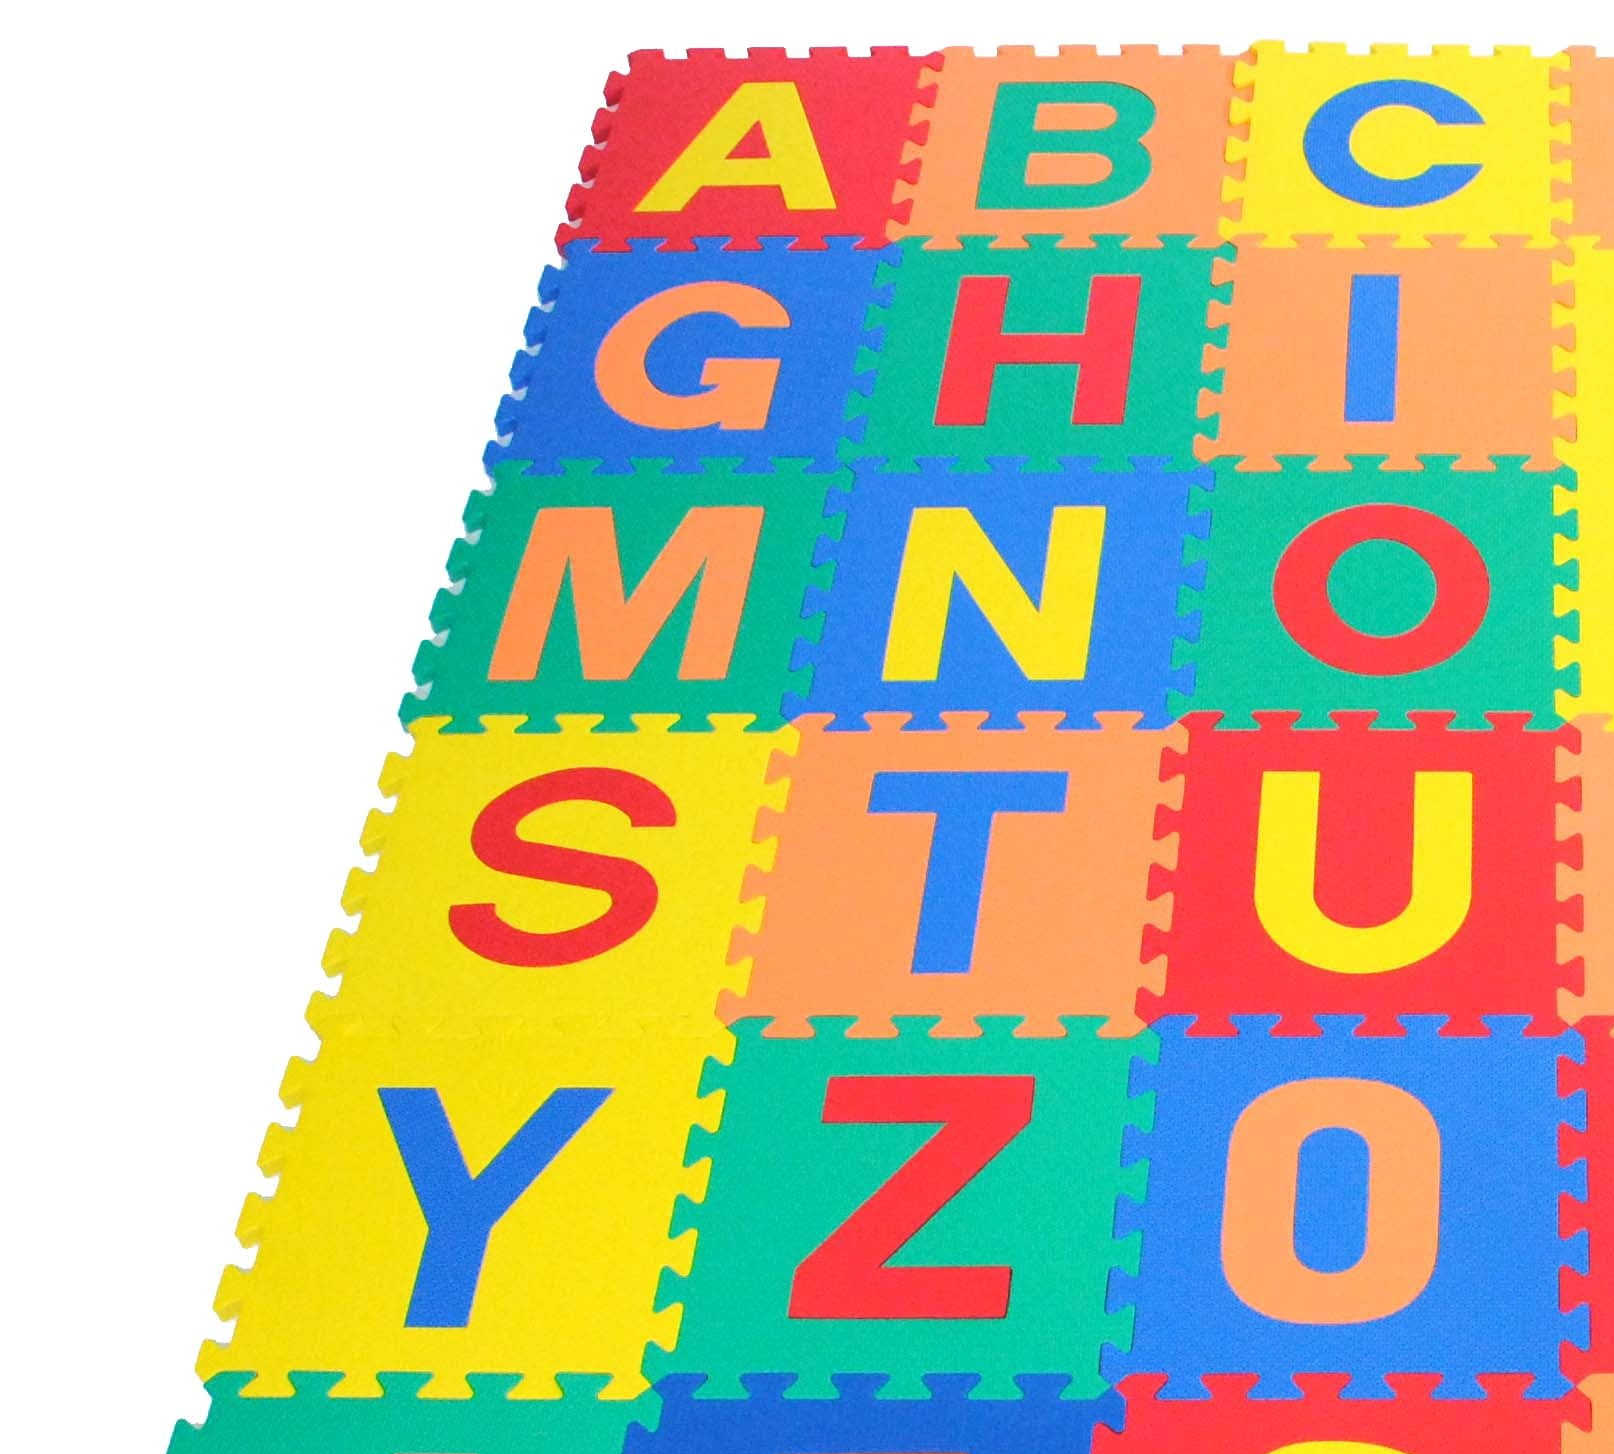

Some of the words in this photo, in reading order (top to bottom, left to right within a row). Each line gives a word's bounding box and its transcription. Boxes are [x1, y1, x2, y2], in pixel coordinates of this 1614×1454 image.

[641, 84, 834, 210] A
[978, 83, 1155, 209] B
[1306, 82, 1480, 206] C
[598, 284, 788, 428] G
[935, 276, 1141, 425] H
[1346, 276, 1398, 421] I
[490, 507, 763, 680] M
[884, 507, 1105, 680] N
[1274, 505, 1490, 675] O
[452, 769, 674, 965] S
[870, 772, 1068, 973] T
[1256, 773, 1472, 973] U
[382, 1089, 610, 1326] Y
[789, 1076, 1034, 1319] Z
[1224, 1080, 1439, 1322] 0
